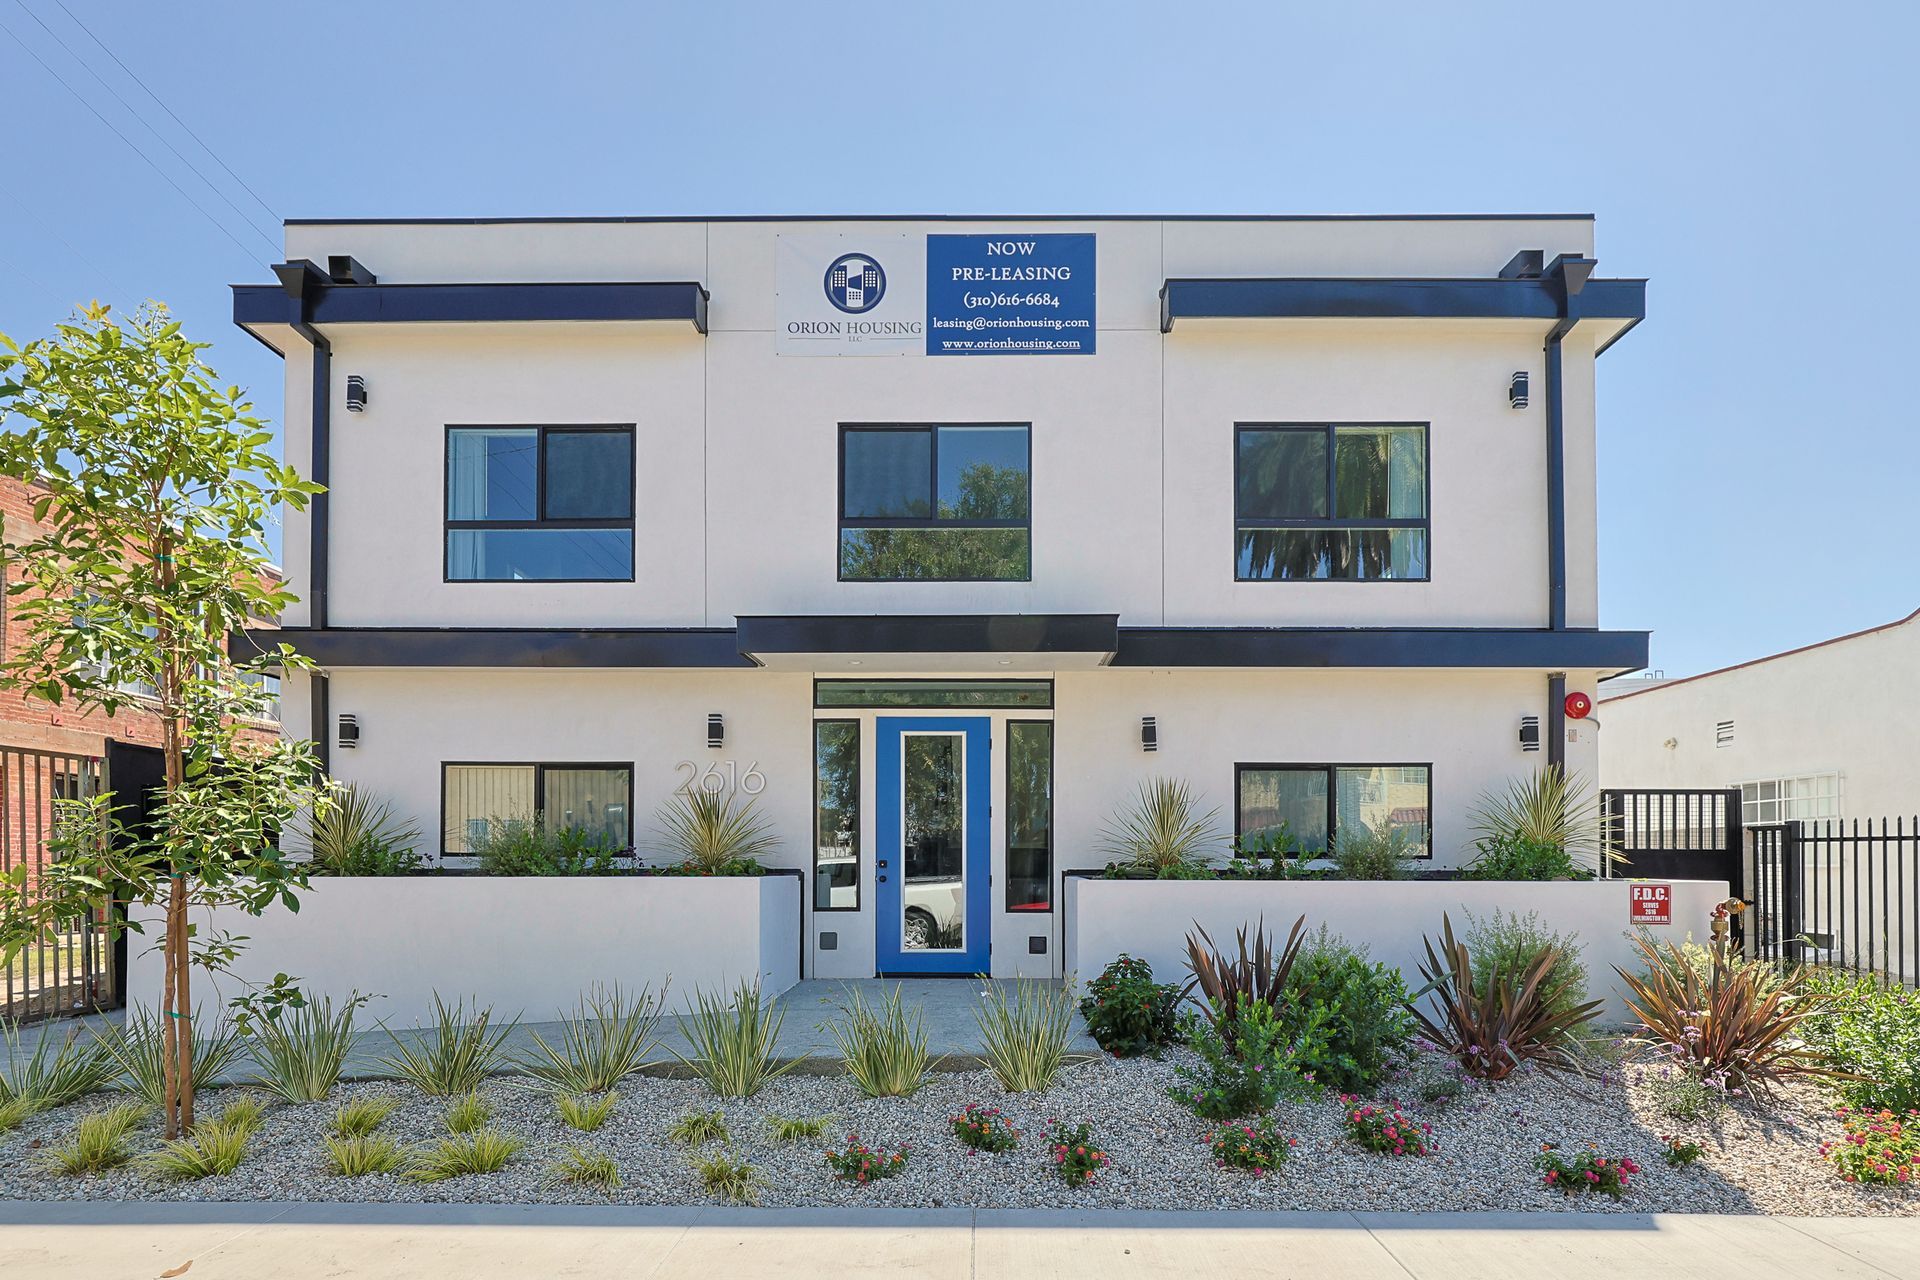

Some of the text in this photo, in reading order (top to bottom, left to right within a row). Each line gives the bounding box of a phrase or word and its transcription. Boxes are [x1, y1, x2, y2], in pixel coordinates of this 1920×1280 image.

[987, 242, 1037, 256] NOW
[951, 266, 1072, 281] PRE-LEASING
[963, 291, 1060, 309] (310)616-6684
[787, 321, 922, 335] ORION HOUSING
[933, 316, 1090, 331] leasing@orionhousing.com
[942, 337, 1081, 350] www.orionhousing.com
[674, 760, 767, 796] 2616
[1633, 887, 1668, 901] F.D.C.
